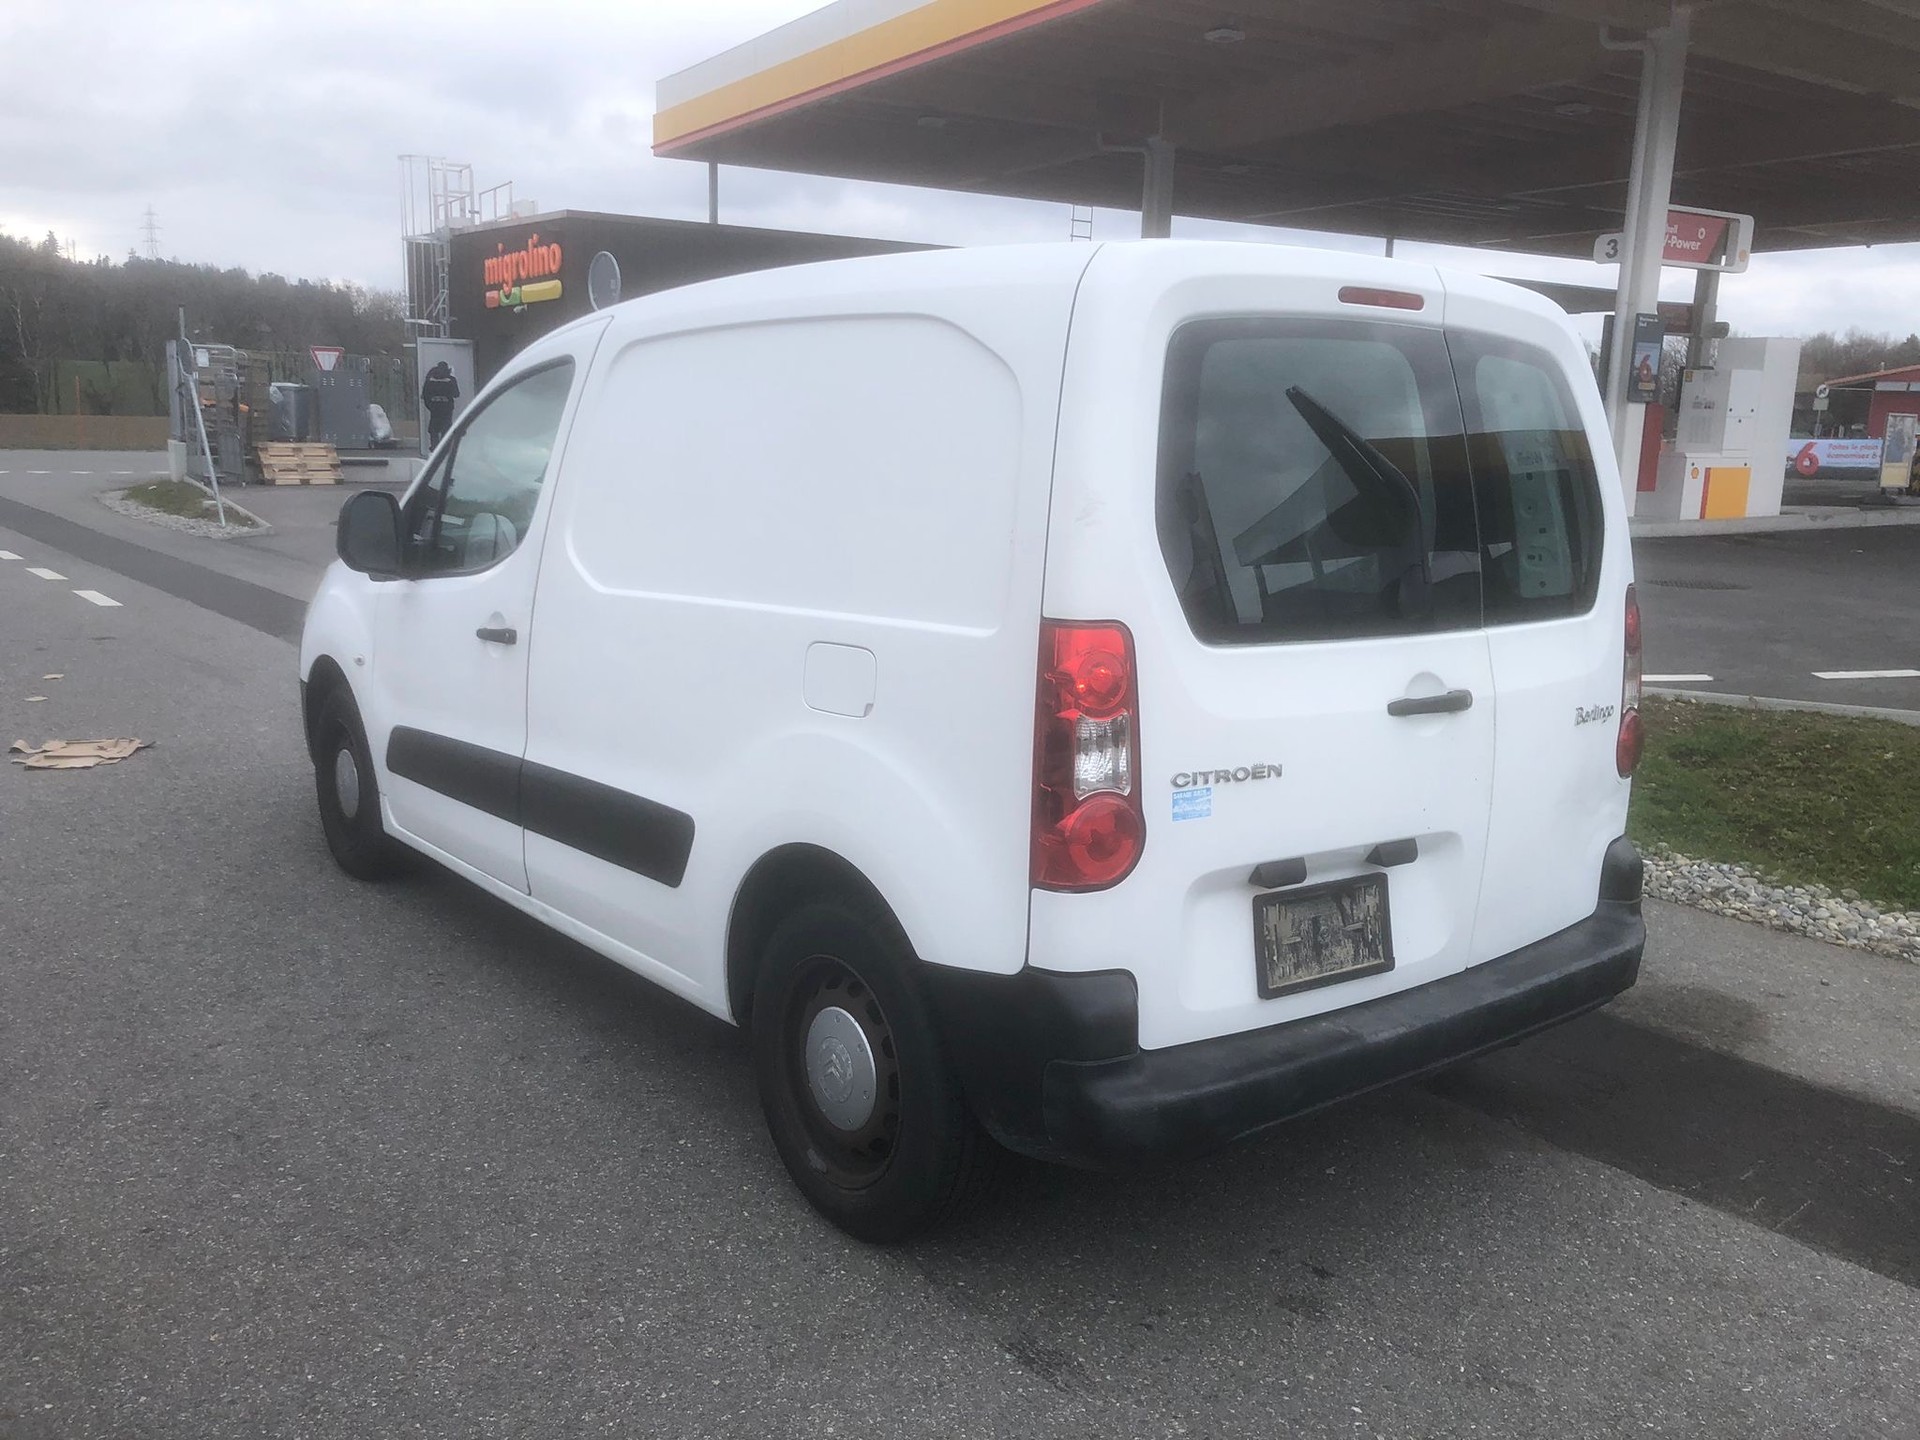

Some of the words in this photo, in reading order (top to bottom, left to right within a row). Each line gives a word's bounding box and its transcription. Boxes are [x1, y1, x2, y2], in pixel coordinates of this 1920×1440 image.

[1605, 238, 1618, 259] 3
[483, 233, 562, 295] migrolino
[1796, 441, 1819, 476] 6
[1170, 763, 1283, 788] CITROËN
